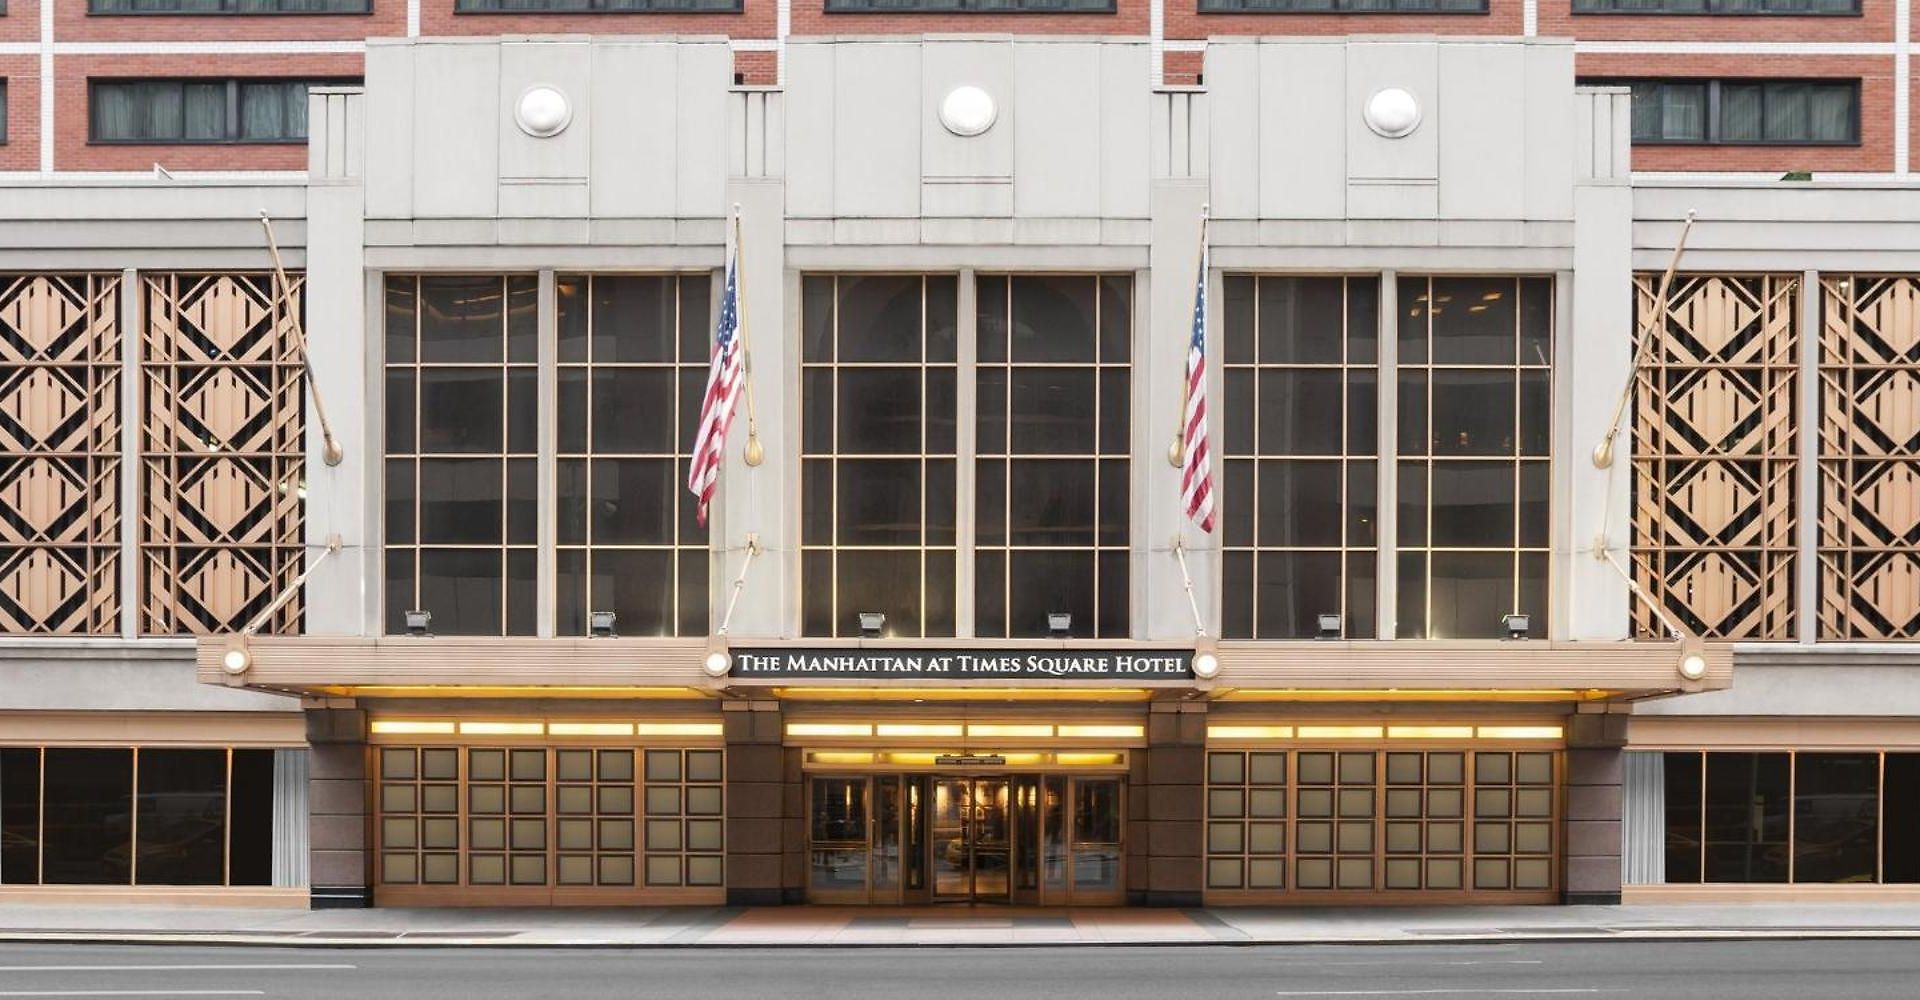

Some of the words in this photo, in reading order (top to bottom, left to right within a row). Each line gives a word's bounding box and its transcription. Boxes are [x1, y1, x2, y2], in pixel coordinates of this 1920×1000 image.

[738, 654, 780, 672] THE
[787, 654, 922, 672] MANHATTAN
[926, 657, 953, 672] AT
[956, 655, 1021, 672] TIMES
[1026, 655, 1108, 676] SQUARE
[1115, 655, 1187, 673] HOTEL
